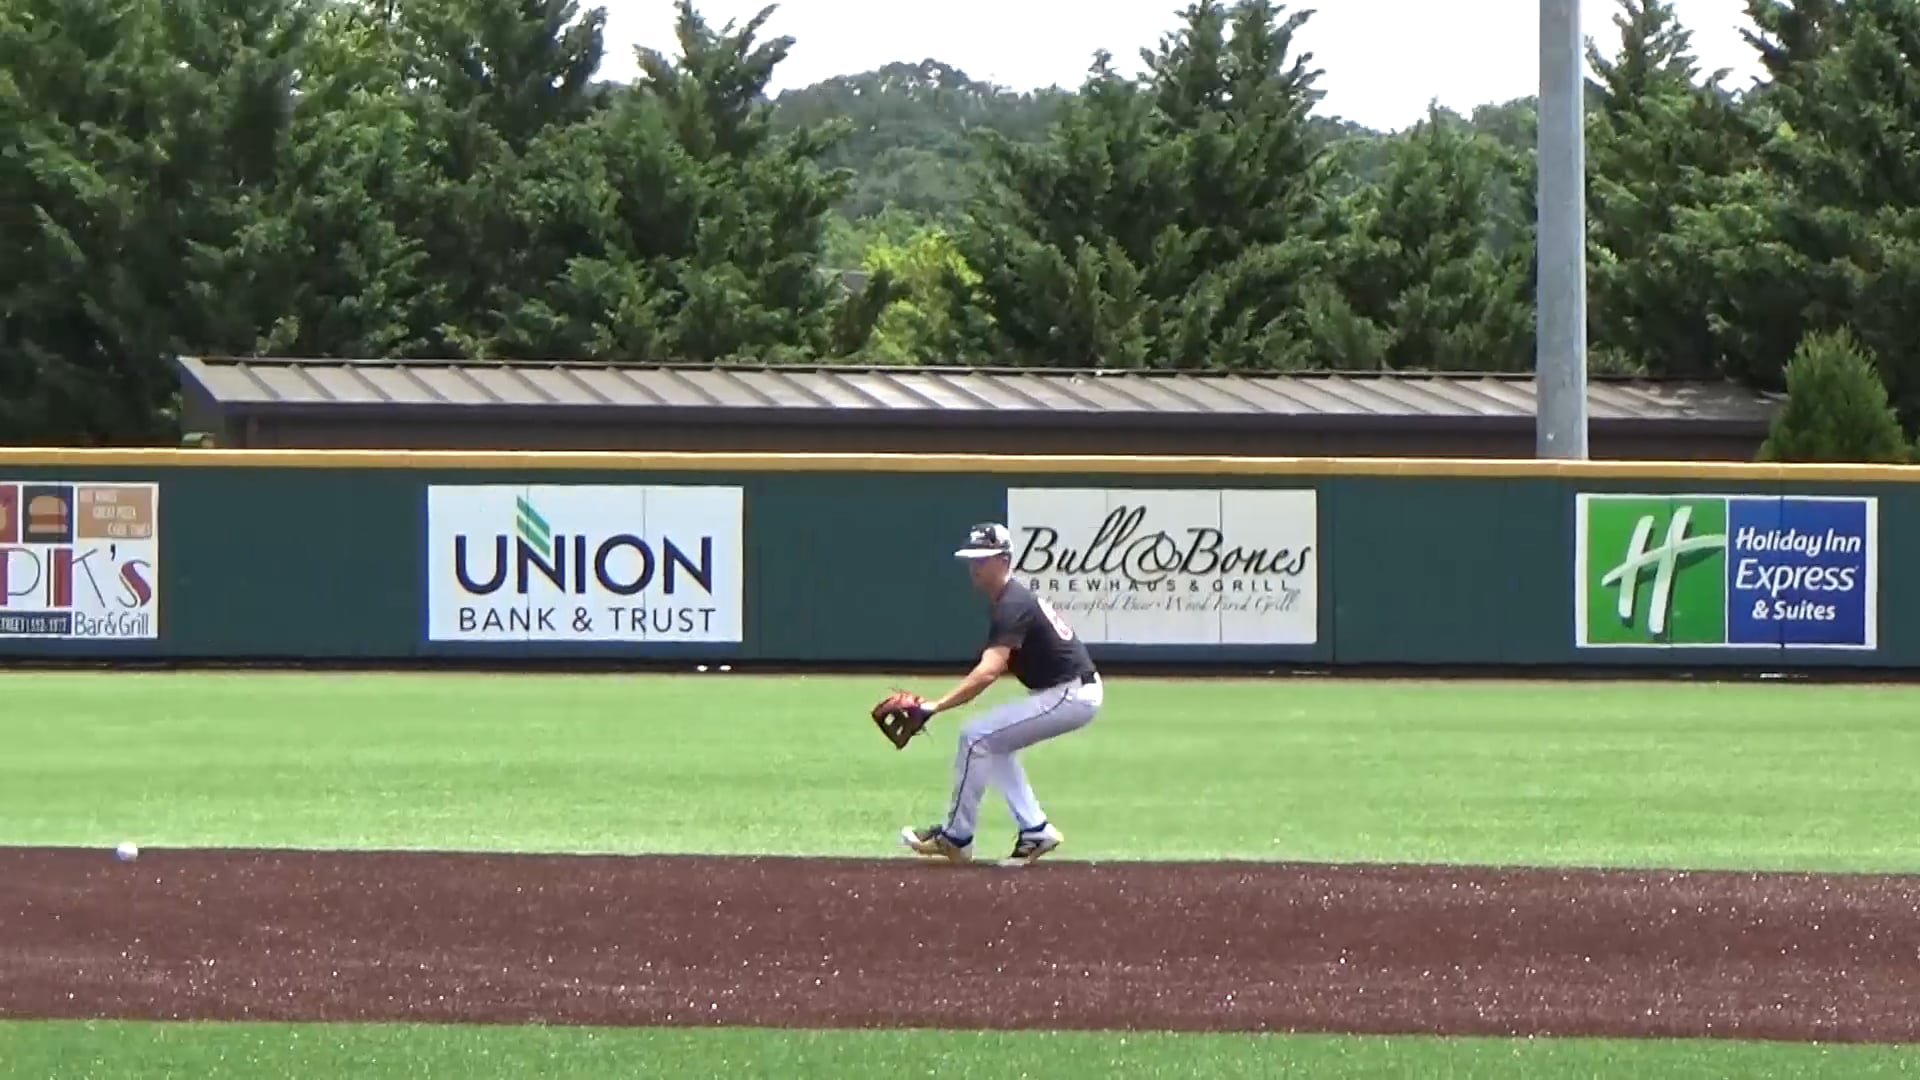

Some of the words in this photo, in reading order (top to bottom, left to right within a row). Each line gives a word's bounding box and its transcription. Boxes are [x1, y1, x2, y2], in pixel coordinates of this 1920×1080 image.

[1012, 505, 1147, 574] Bull
[1179, 527, 1311, 576] Bones
[1735, 527, 1822, 557] Holiday
[1825, 528, 1861, 553] Inn
[455, 534, 712, 595] UNION
[1736, 559, 1856, 597] Express
[1030, 579, 1176, 592] BREWHAUS
[1189, 579, 1199, 592] &
[1212, 580, 1288, 592] GRILL
[459, 607, 556, 632] BANK
[572, 607, 593, 632] &
[608, 607, 716, 633] TRUST
[1752, 599, 1769, 620] &
[1773, 600, 1836, 620] Suites
